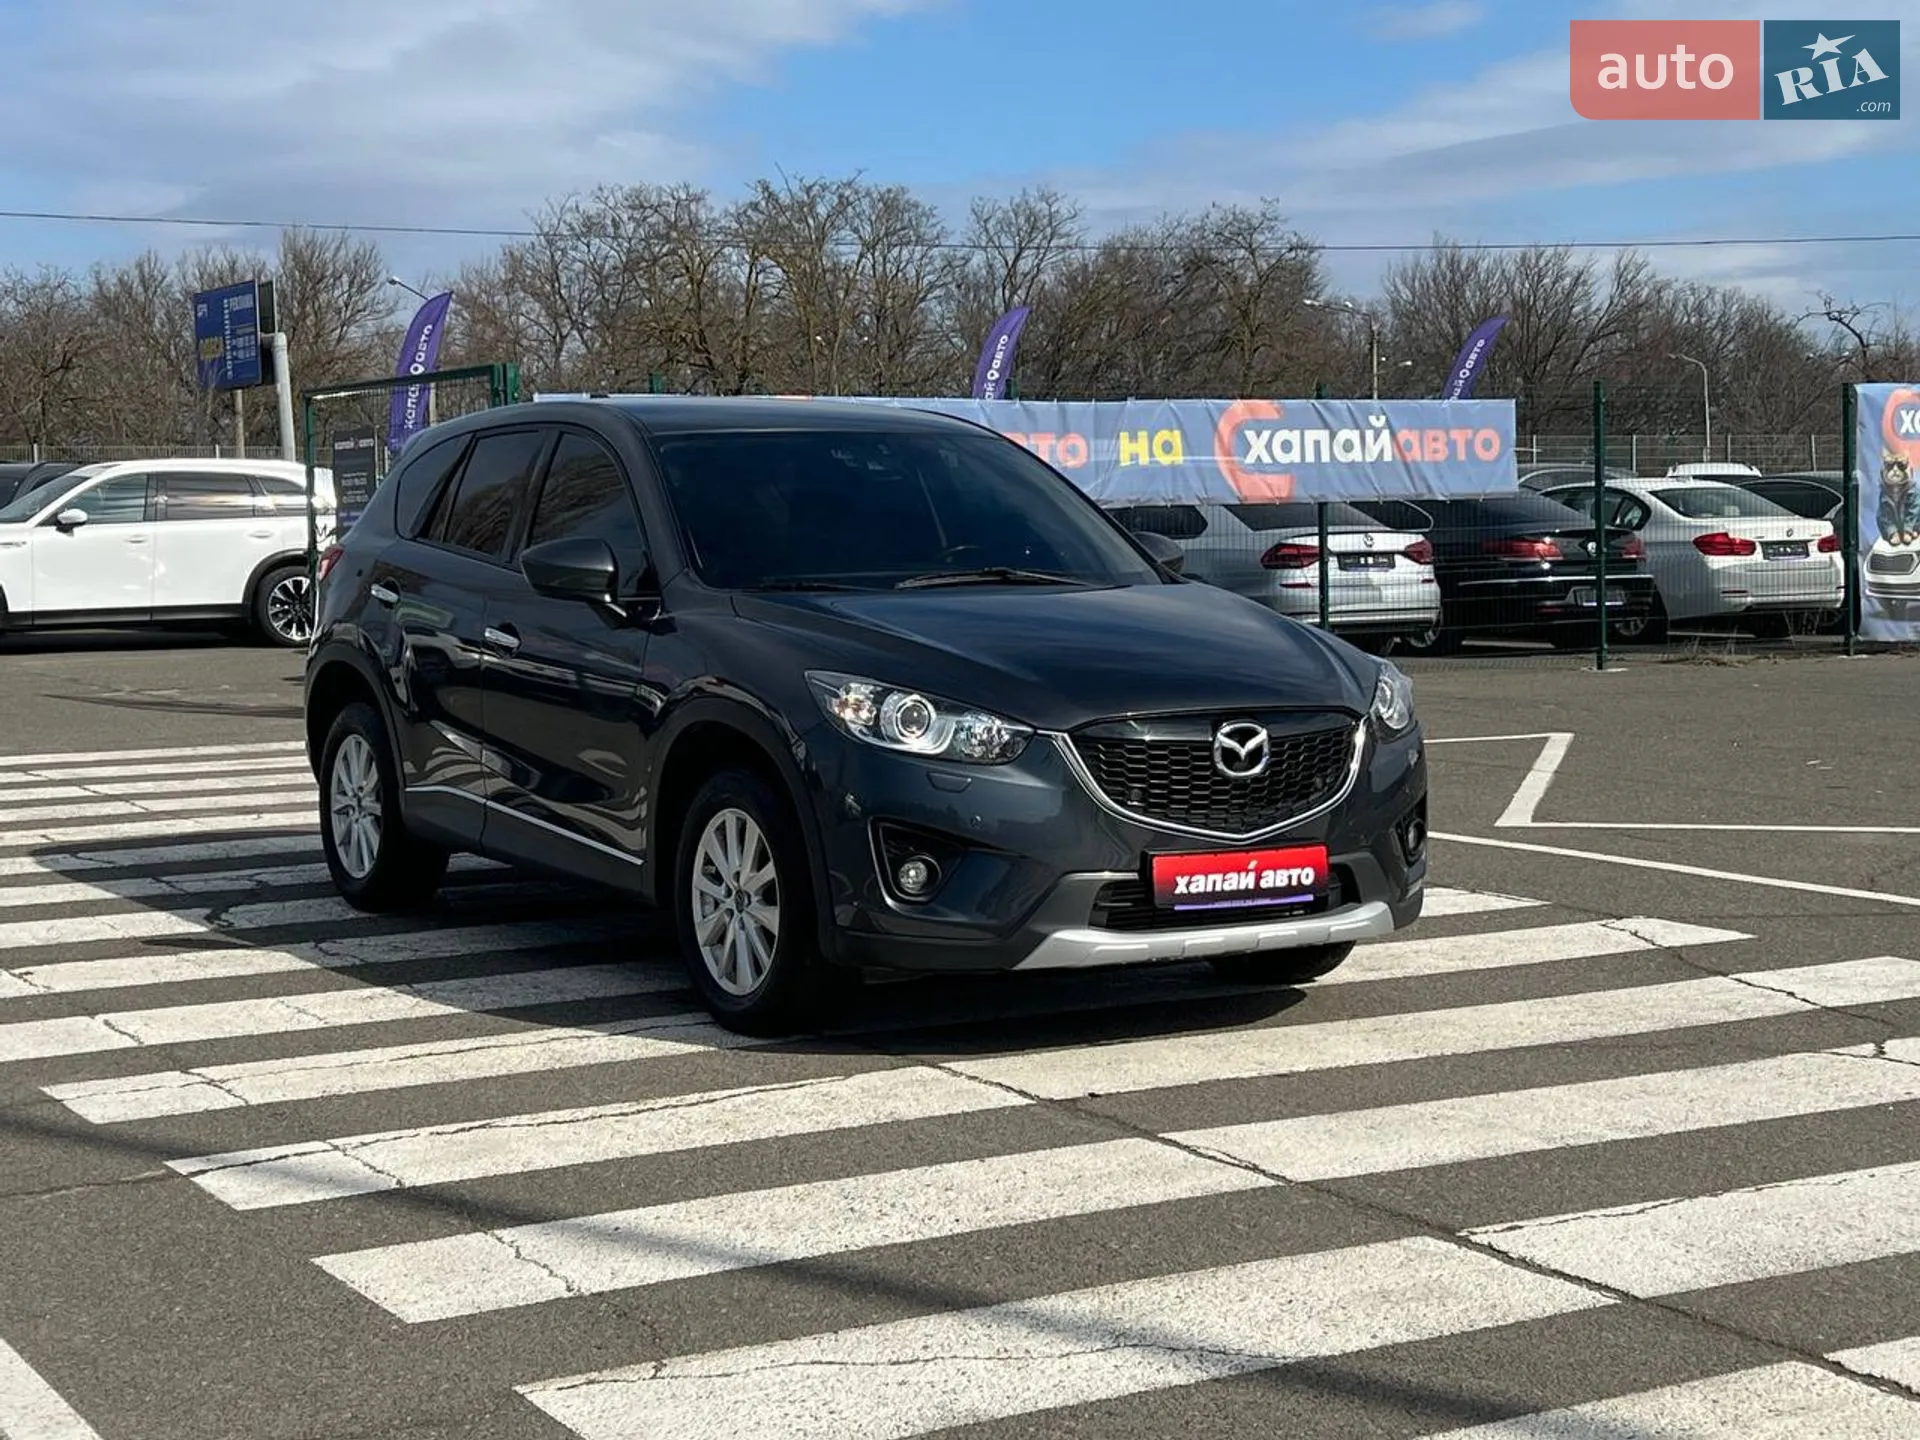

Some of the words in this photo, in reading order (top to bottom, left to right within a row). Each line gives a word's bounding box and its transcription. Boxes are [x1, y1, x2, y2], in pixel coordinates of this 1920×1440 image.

[992, 334, 1009, 369] авто
[1465, 338, 1486, 370] авто
[404, 383, 421, 430] хапа
[1119, 428, 1184, 467] на
[1174, 860, 1257, 894] хапай
[1259, 867, 1315, 889] авто
